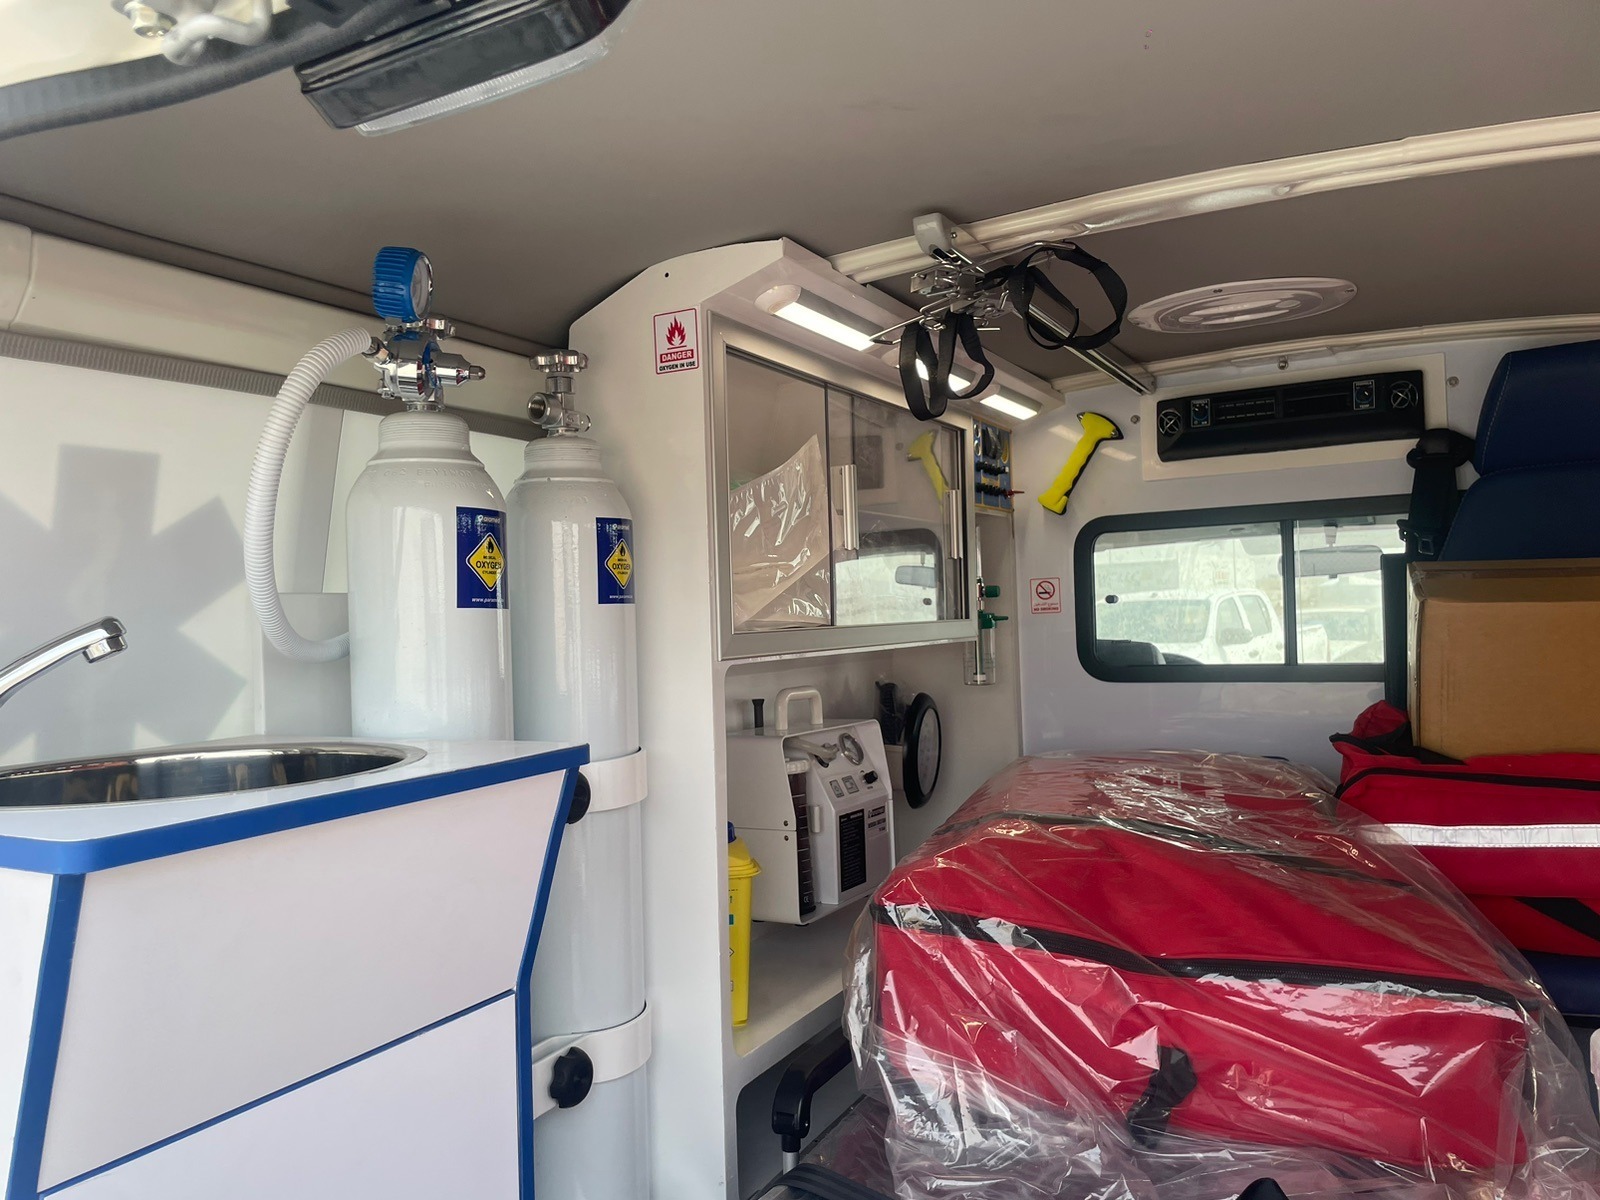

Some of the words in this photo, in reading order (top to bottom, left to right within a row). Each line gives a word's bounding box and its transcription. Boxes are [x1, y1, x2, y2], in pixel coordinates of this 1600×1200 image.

[661, 350, 693, 362] DANGER
[659, 363, 679, 372] OXYGEN
[686, 360, 696, 368] USE
